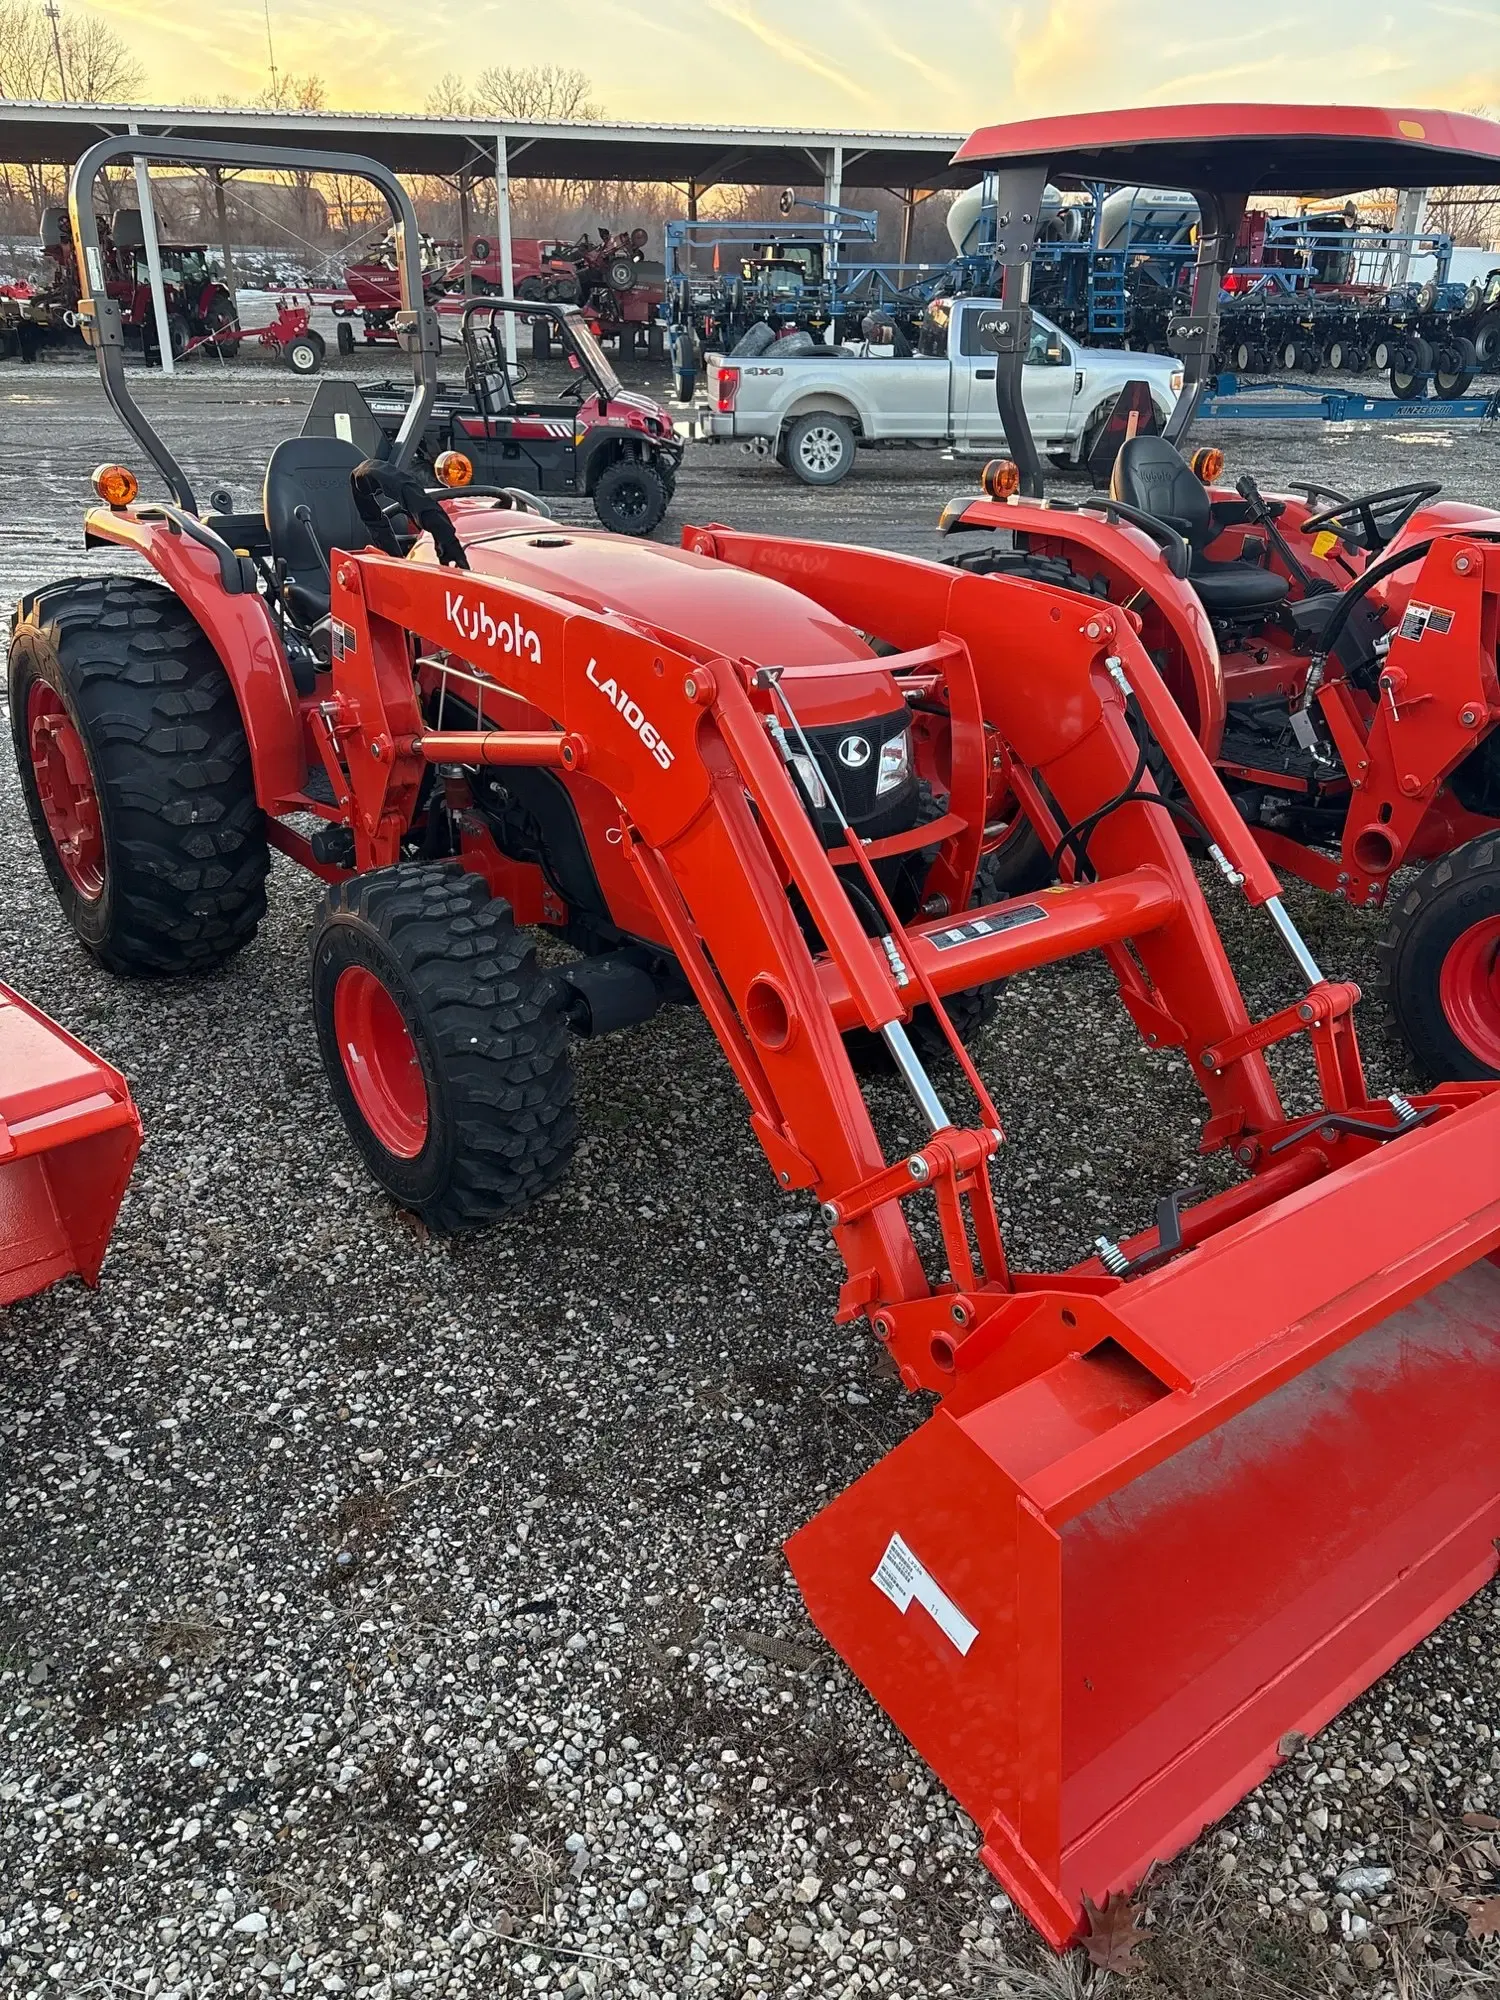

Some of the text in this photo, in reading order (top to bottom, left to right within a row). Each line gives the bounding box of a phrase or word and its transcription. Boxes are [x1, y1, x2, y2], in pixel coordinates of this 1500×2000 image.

[371, 403, 405, 411] Kawasaki
[445, 590, 542, 665] Kubota
[586, 657, 675, 770] LA1065
